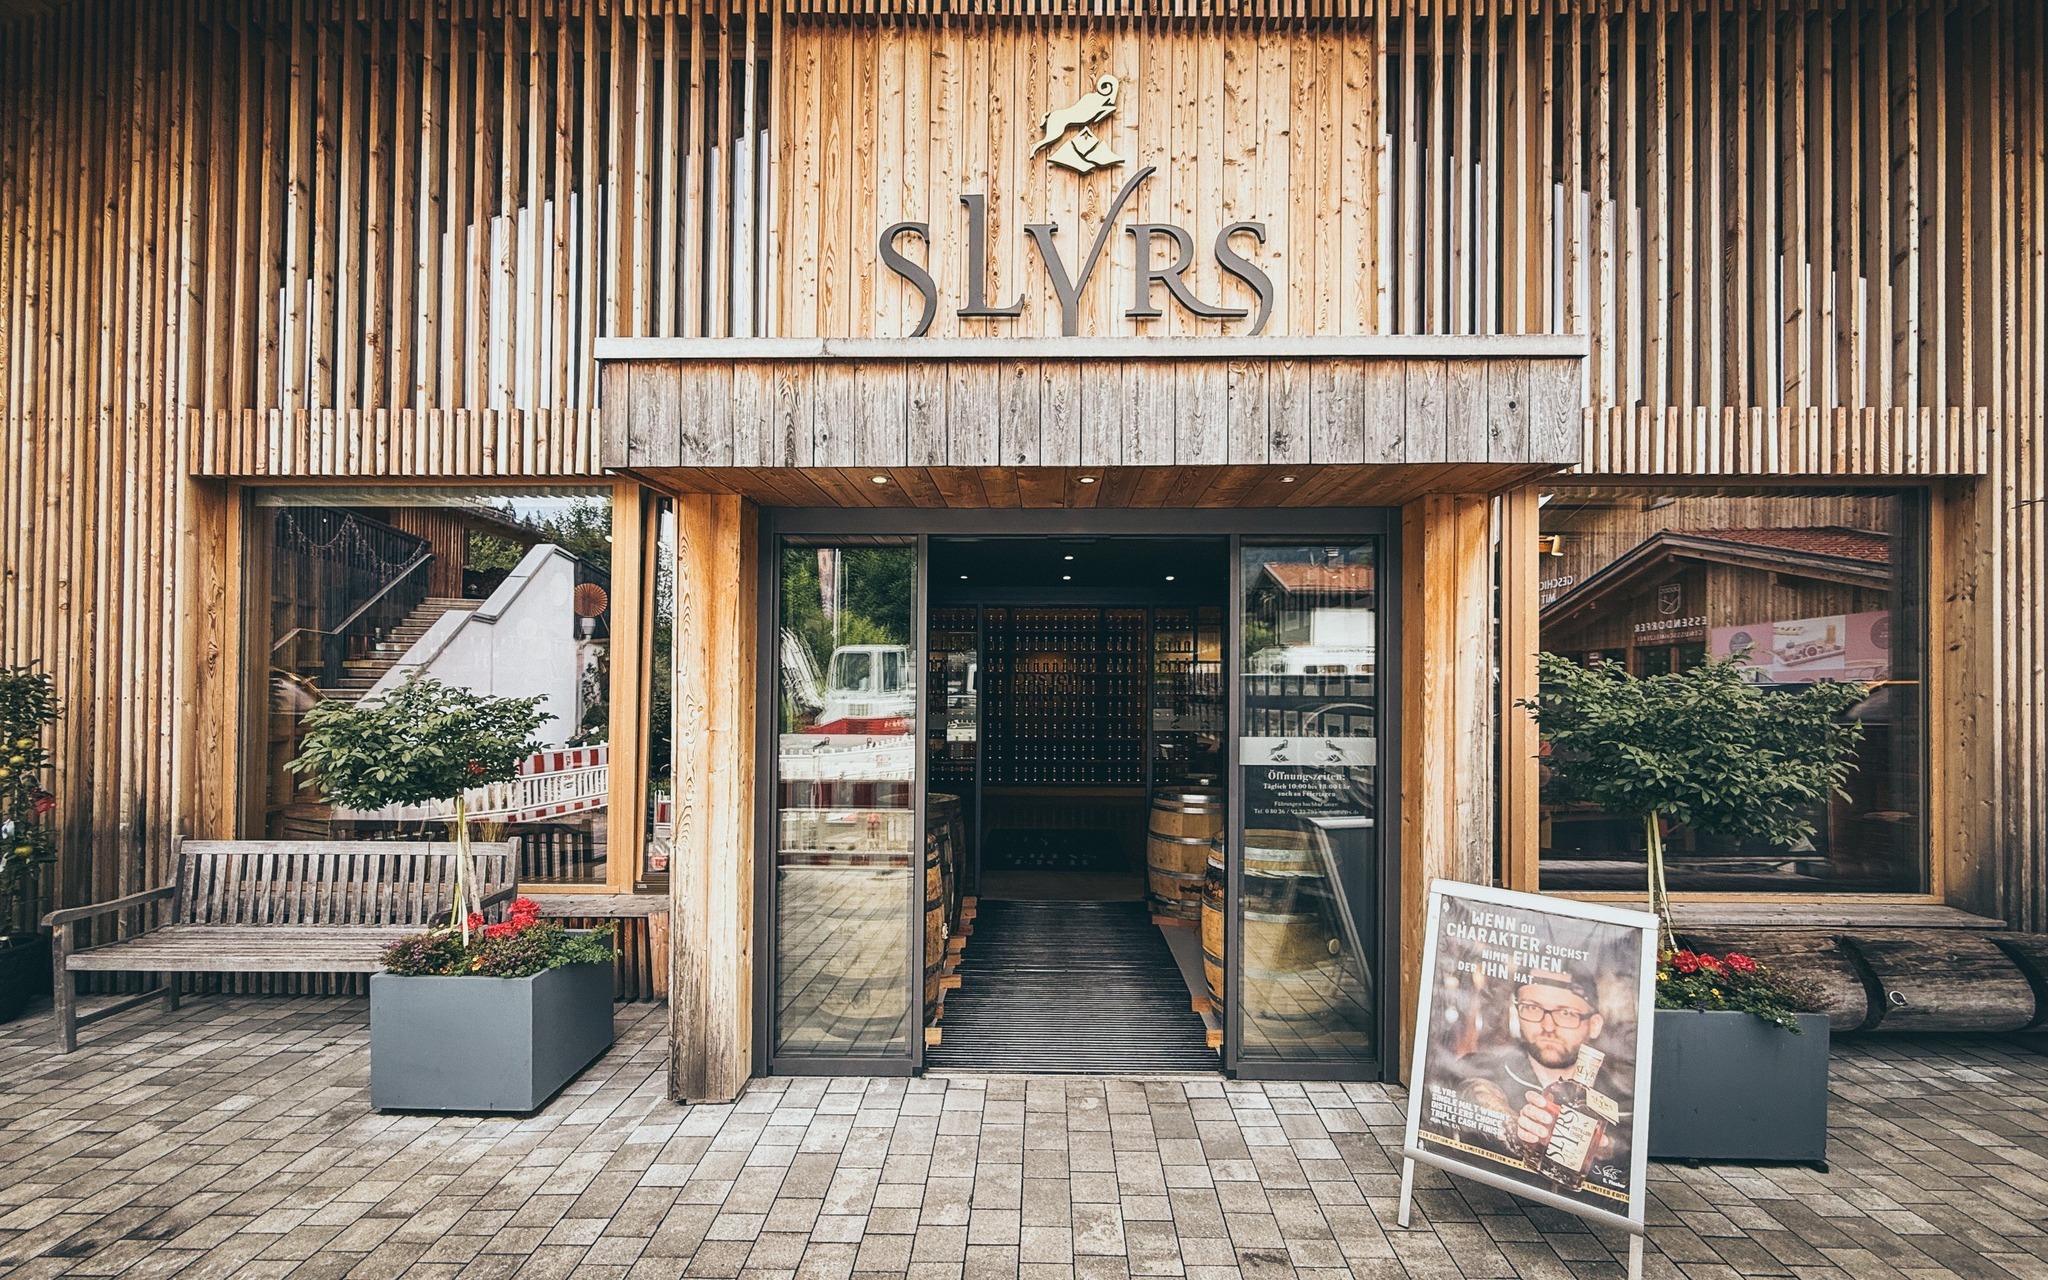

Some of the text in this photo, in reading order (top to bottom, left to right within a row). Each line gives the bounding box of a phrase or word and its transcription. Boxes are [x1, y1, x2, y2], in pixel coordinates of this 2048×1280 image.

[880, 166, 1274, 338] SLYRS
[1268, 769, 1346, 782] Öffnungszeiten:
[1302, 790, 1336, 799] Feiertagen
[1471, 910, 1536, 935] WENN DU
[1446, 922, 1590, 962] CHARAKTER SUCHST
[1482, 949, 1509, 964] NIMM
[1458, 960, 1538, 985] DER IHN HAT.
[1432, 1085, 1457, 1098] SLYRS
[1431, 1093, 1458, 1108] SINGLE
[1458, 1100, 1480, 1113] MALT
[1430, 1108, 1457, 1123] TRIPLE
[1478, 1122, 1505, 1139] FINISH
[1431, 1100, 1504, 1129] DISTILLERS CHOICE
[1429, 1134, 1449, 1144] EDITION
[1463, 1145, 1506, 1162] LIMITED EDITION
[1586, 1184, 1611, 1195] LIMITED
